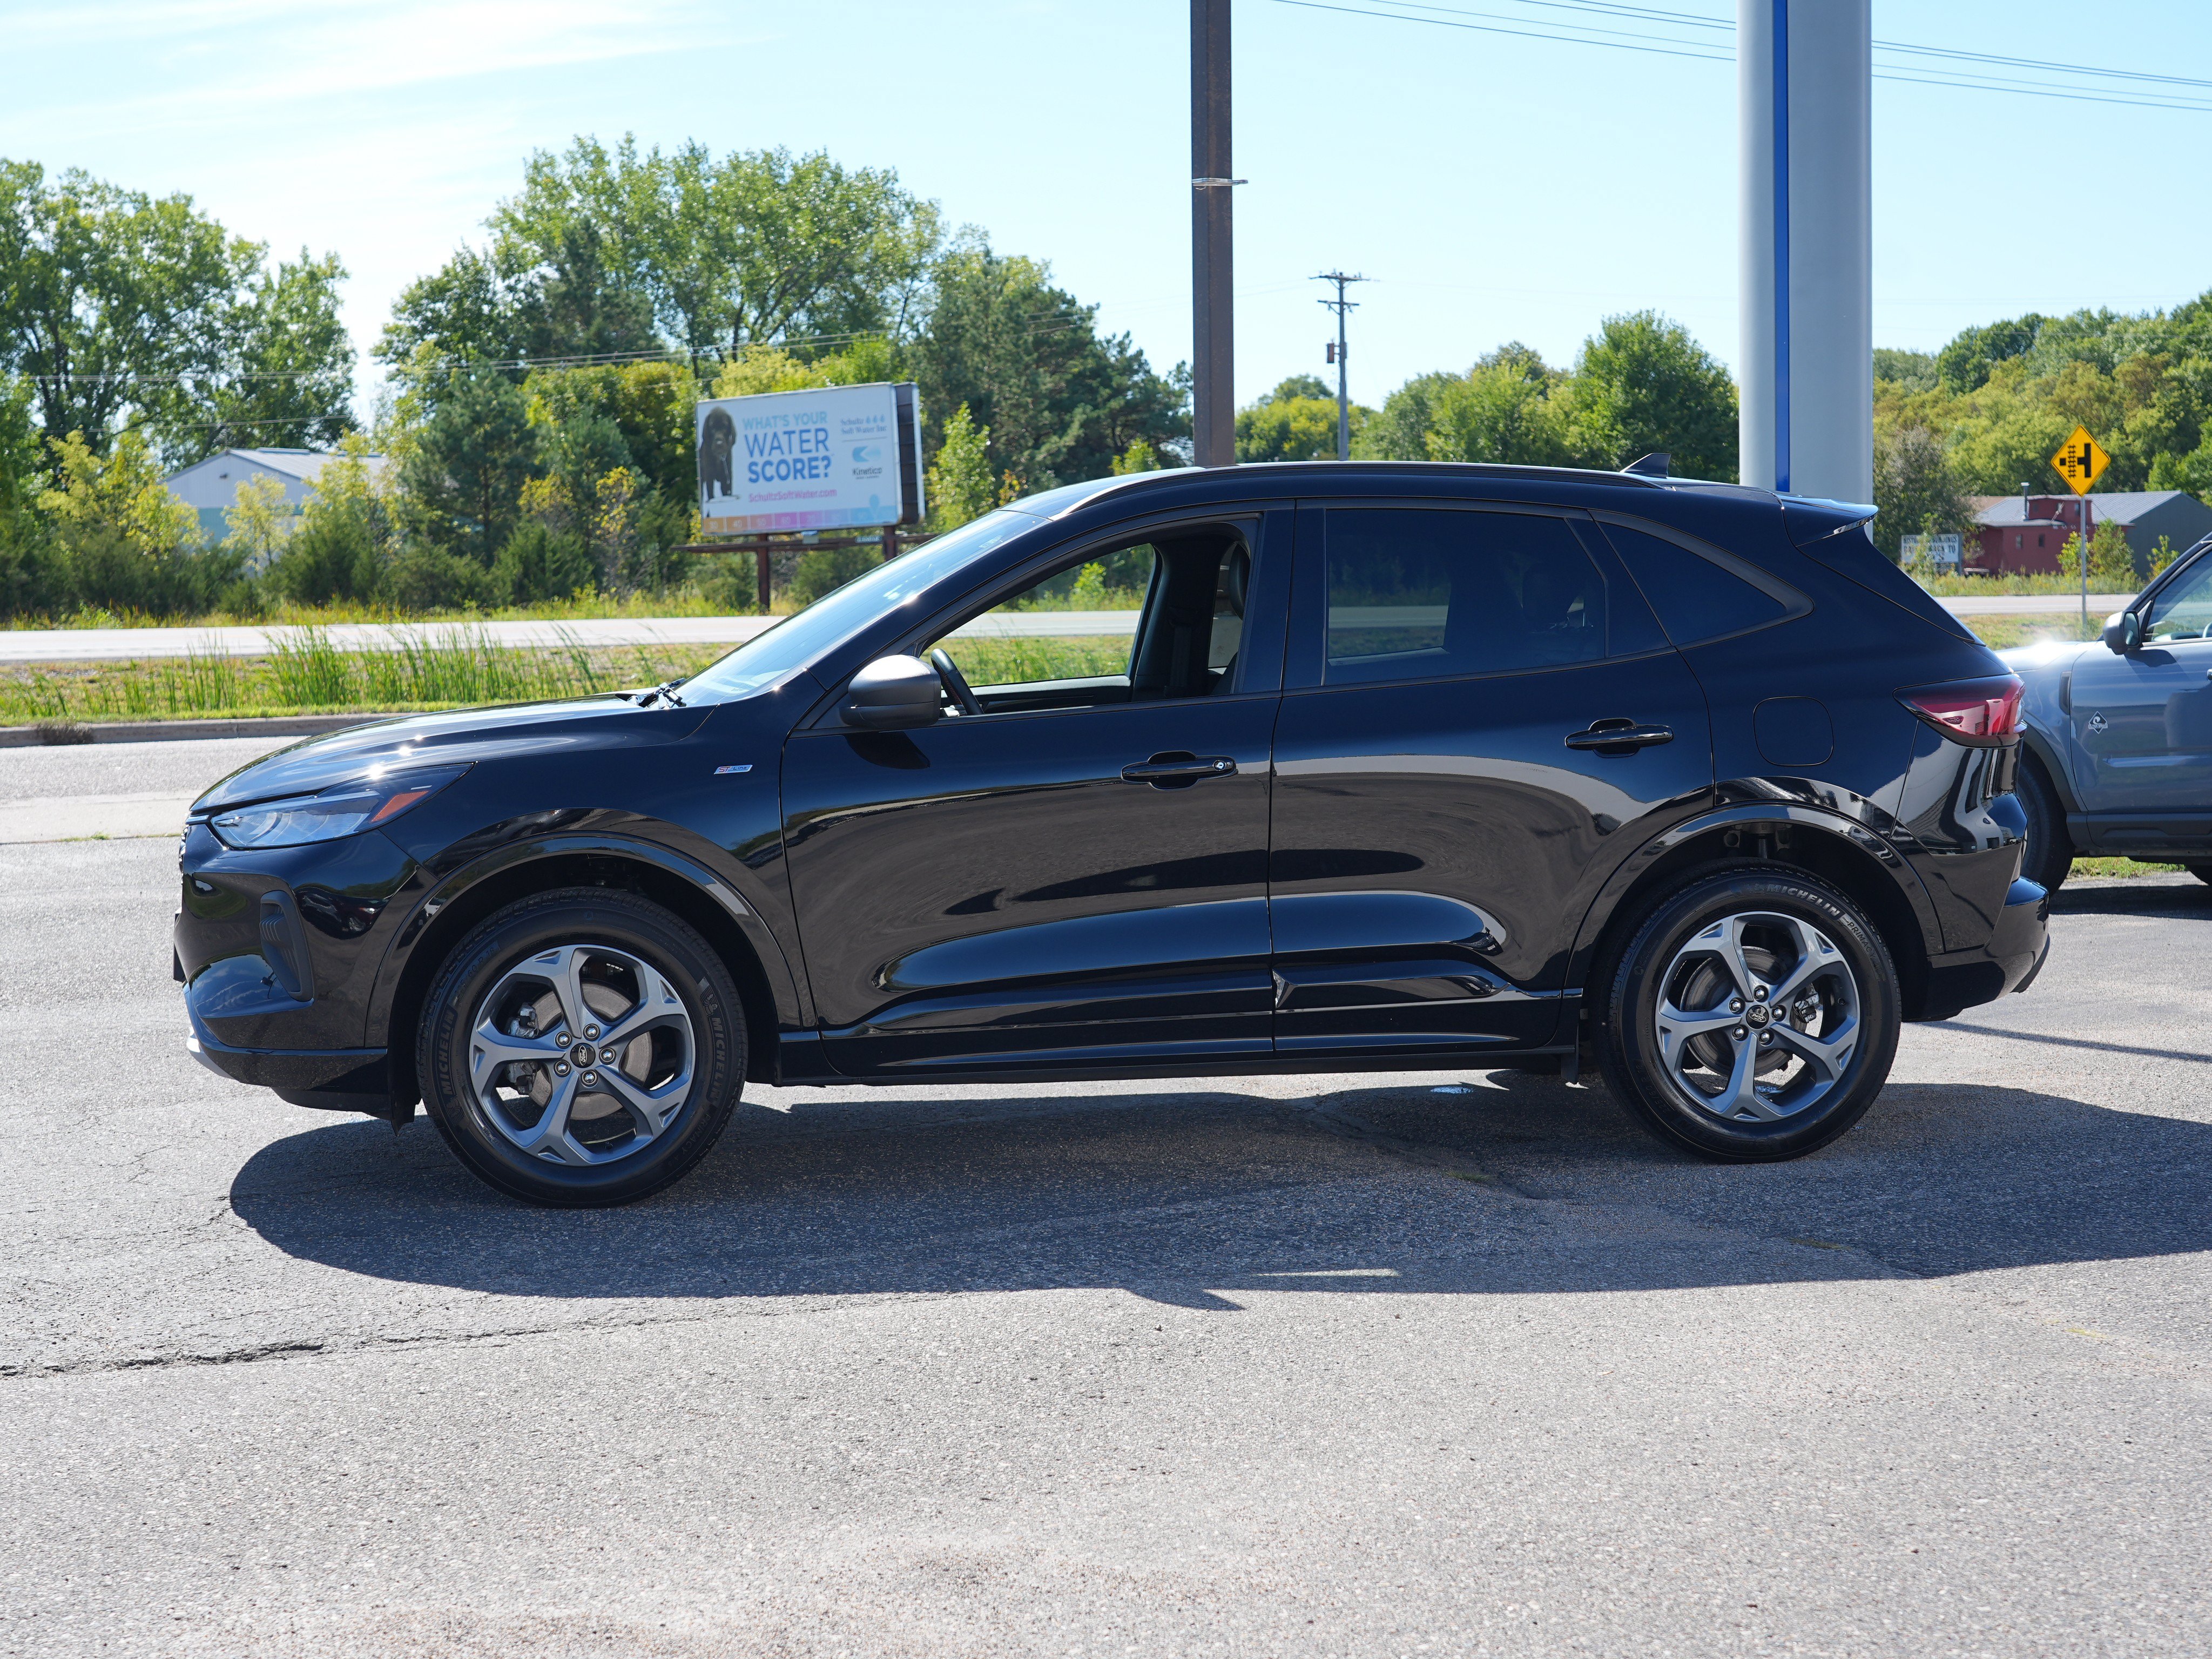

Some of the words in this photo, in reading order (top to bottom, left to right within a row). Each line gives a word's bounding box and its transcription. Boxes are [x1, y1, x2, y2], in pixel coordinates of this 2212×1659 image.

[743, 414, 790, 430] WHAT'S
[793, 411, 828, 426] YOUR
[744, 428, 829, 457] WATER
[748, 455, 832, 483] SCORE?
[749, 489, 837, 503] SchultzSoftWater.com
[1948, 544, 1956, 553] TO
[1766, 884, 1840, 916] MICHELIN
[1847, 921, 1876, 961] PRIMACY
[439, 1011, 455, 1095] MICHELIN
[709, 1017, 726, 1100] MICHELIN
